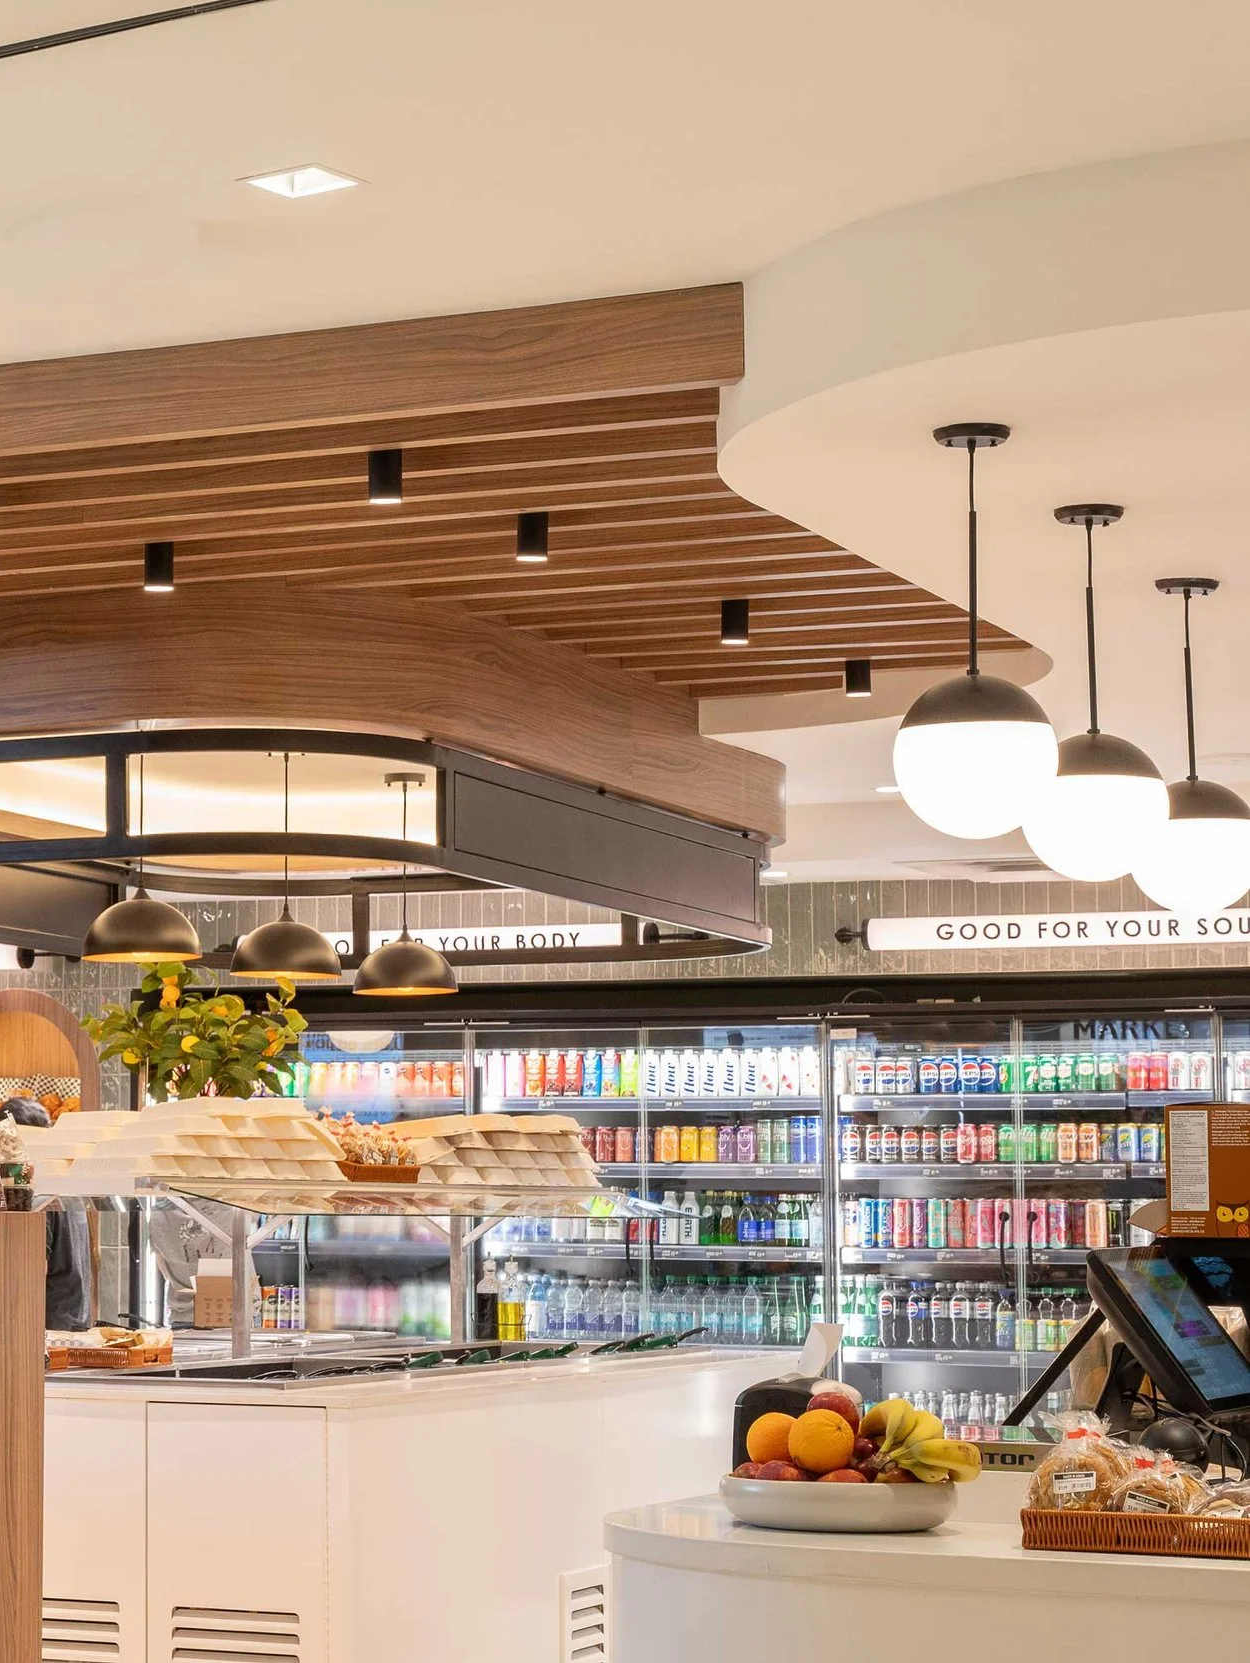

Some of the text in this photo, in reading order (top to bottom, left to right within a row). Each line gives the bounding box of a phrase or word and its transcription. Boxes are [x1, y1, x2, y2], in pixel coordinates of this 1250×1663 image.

[439, 935, 501, 951] YOUR
[516, 931, 581, 950] BODY
[936, 922, 1022, 941] GOOD
[1038, 920, 1090, 939] FOR
[1106, 918, 1181, 938] YOUR
[685, 1207, 693, 1237] ERTH
